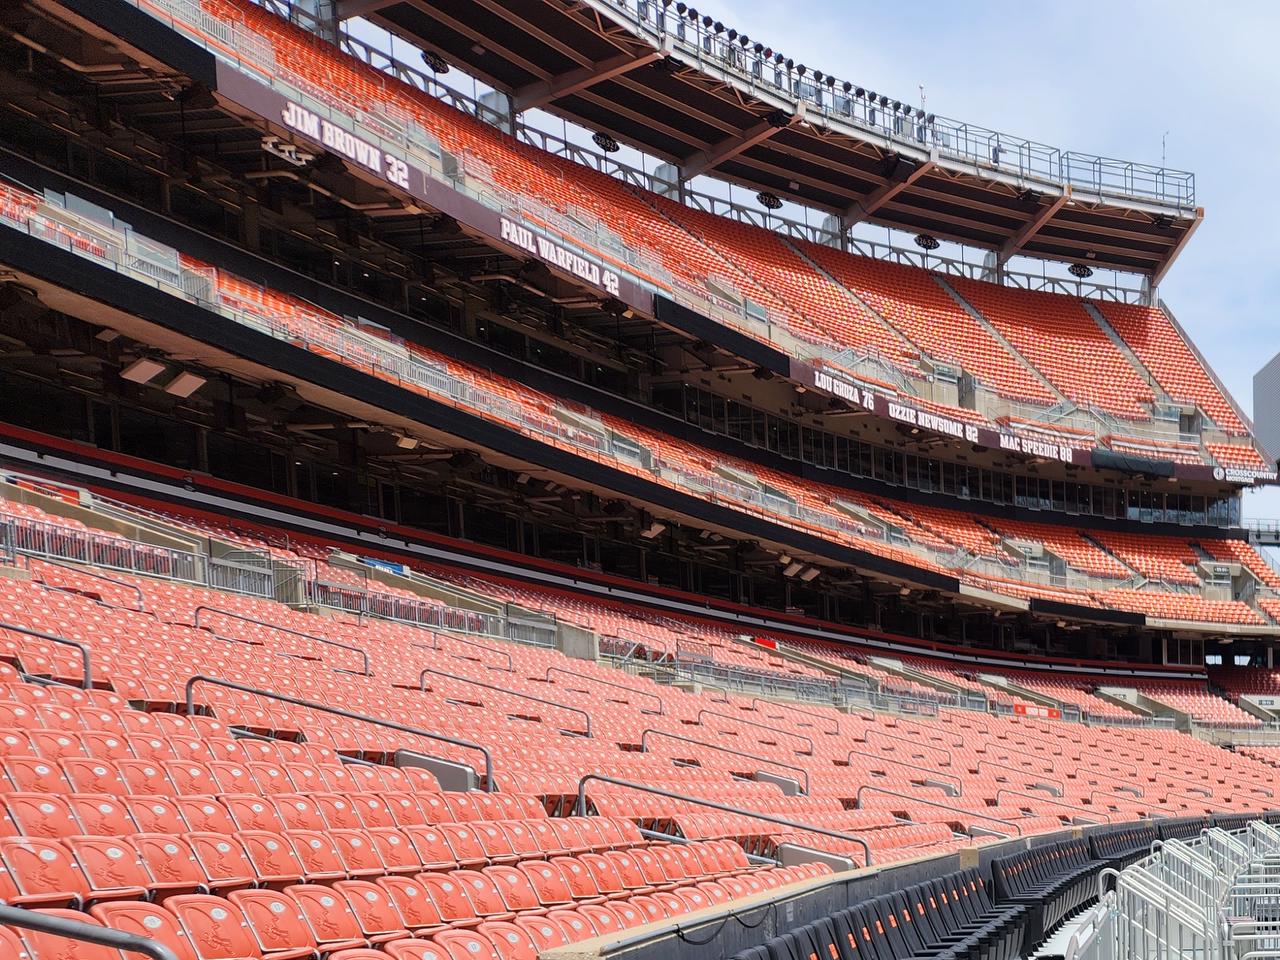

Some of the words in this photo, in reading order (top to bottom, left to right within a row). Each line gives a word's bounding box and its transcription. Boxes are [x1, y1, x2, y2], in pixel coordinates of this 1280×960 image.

[282, 101, 320, 141] JIM
[321, 119, 381, 173] BROWN
[384, 154, 409, 190] 32
[500, 217, 537, 254] PAUL
[536, 235, 600, 287] WARFIELD
[601, 269, 620, 297] 42
[814, 370, 833, 393] LOU
[832, 377, 860, 405] GROZA
[862, 392, 875, 411] 76
[888, 402, 917, 425] OZZIE
[917, 411, 964, 438] NEWSOME
[965, 424, 979, 444] 82
[1000, 434, 1021, 451] MAC
[1021, 439, 1058, 460] SPEEDIE
[1059, 447, 1073, 463] 88
[1225, 468, 1278, 480] CROSSCOUNTRY
